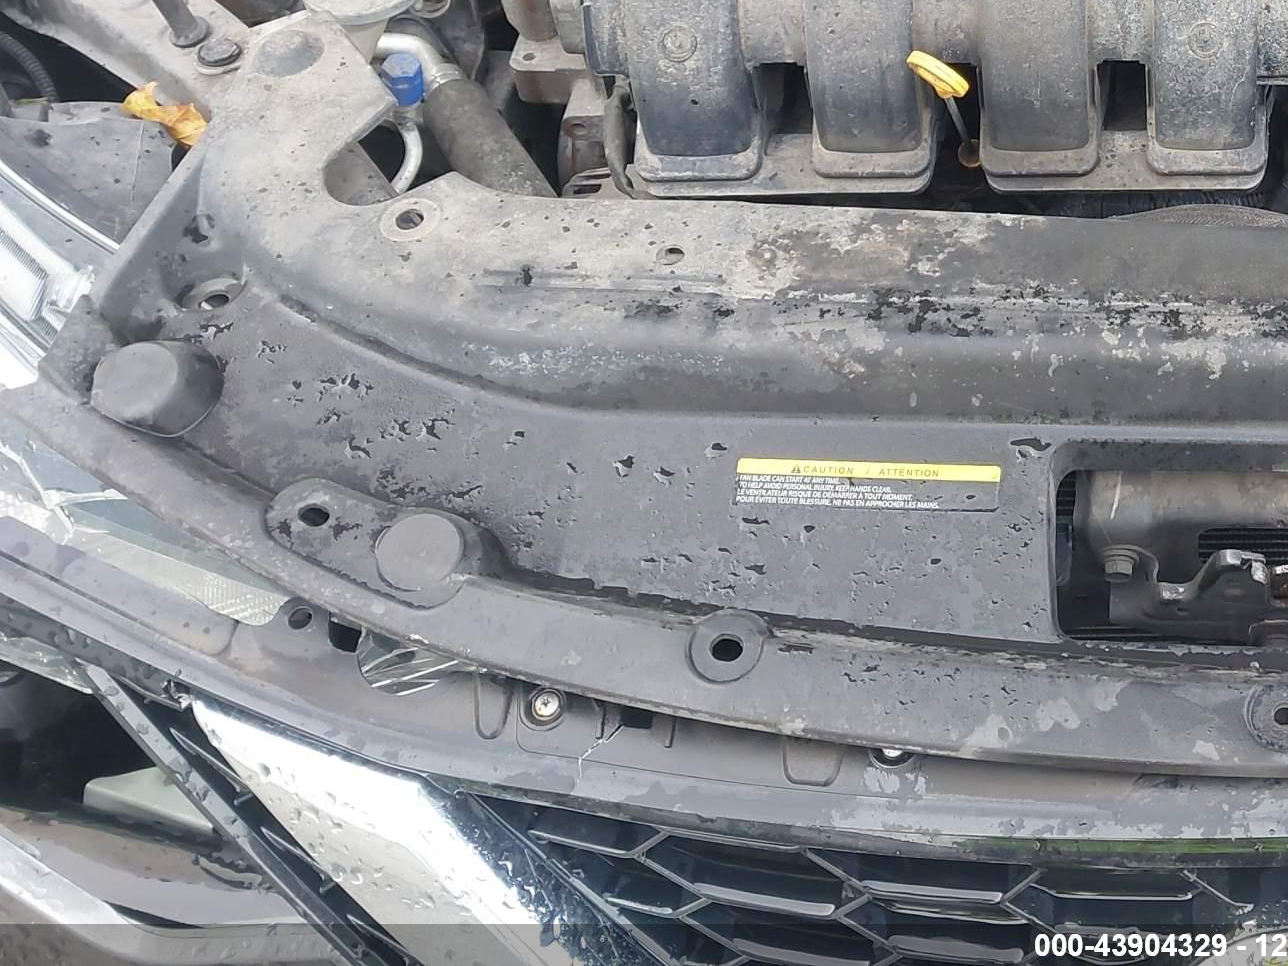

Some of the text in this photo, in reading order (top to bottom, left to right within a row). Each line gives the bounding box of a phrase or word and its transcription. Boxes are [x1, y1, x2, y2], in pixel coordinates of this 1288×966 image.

[803, 465, 853, 475] CAUTION
[878, 468, 940, 477] ATTENTION
[783, 483, 813, 491] PERSONAL
[745, 489, 787, 497] VENTILATEUR
[864, 492, 882, 500] TOUT
[755, 495, 777, 504] ÉVITER
[865, 500, 904, 508] APPROCHER
